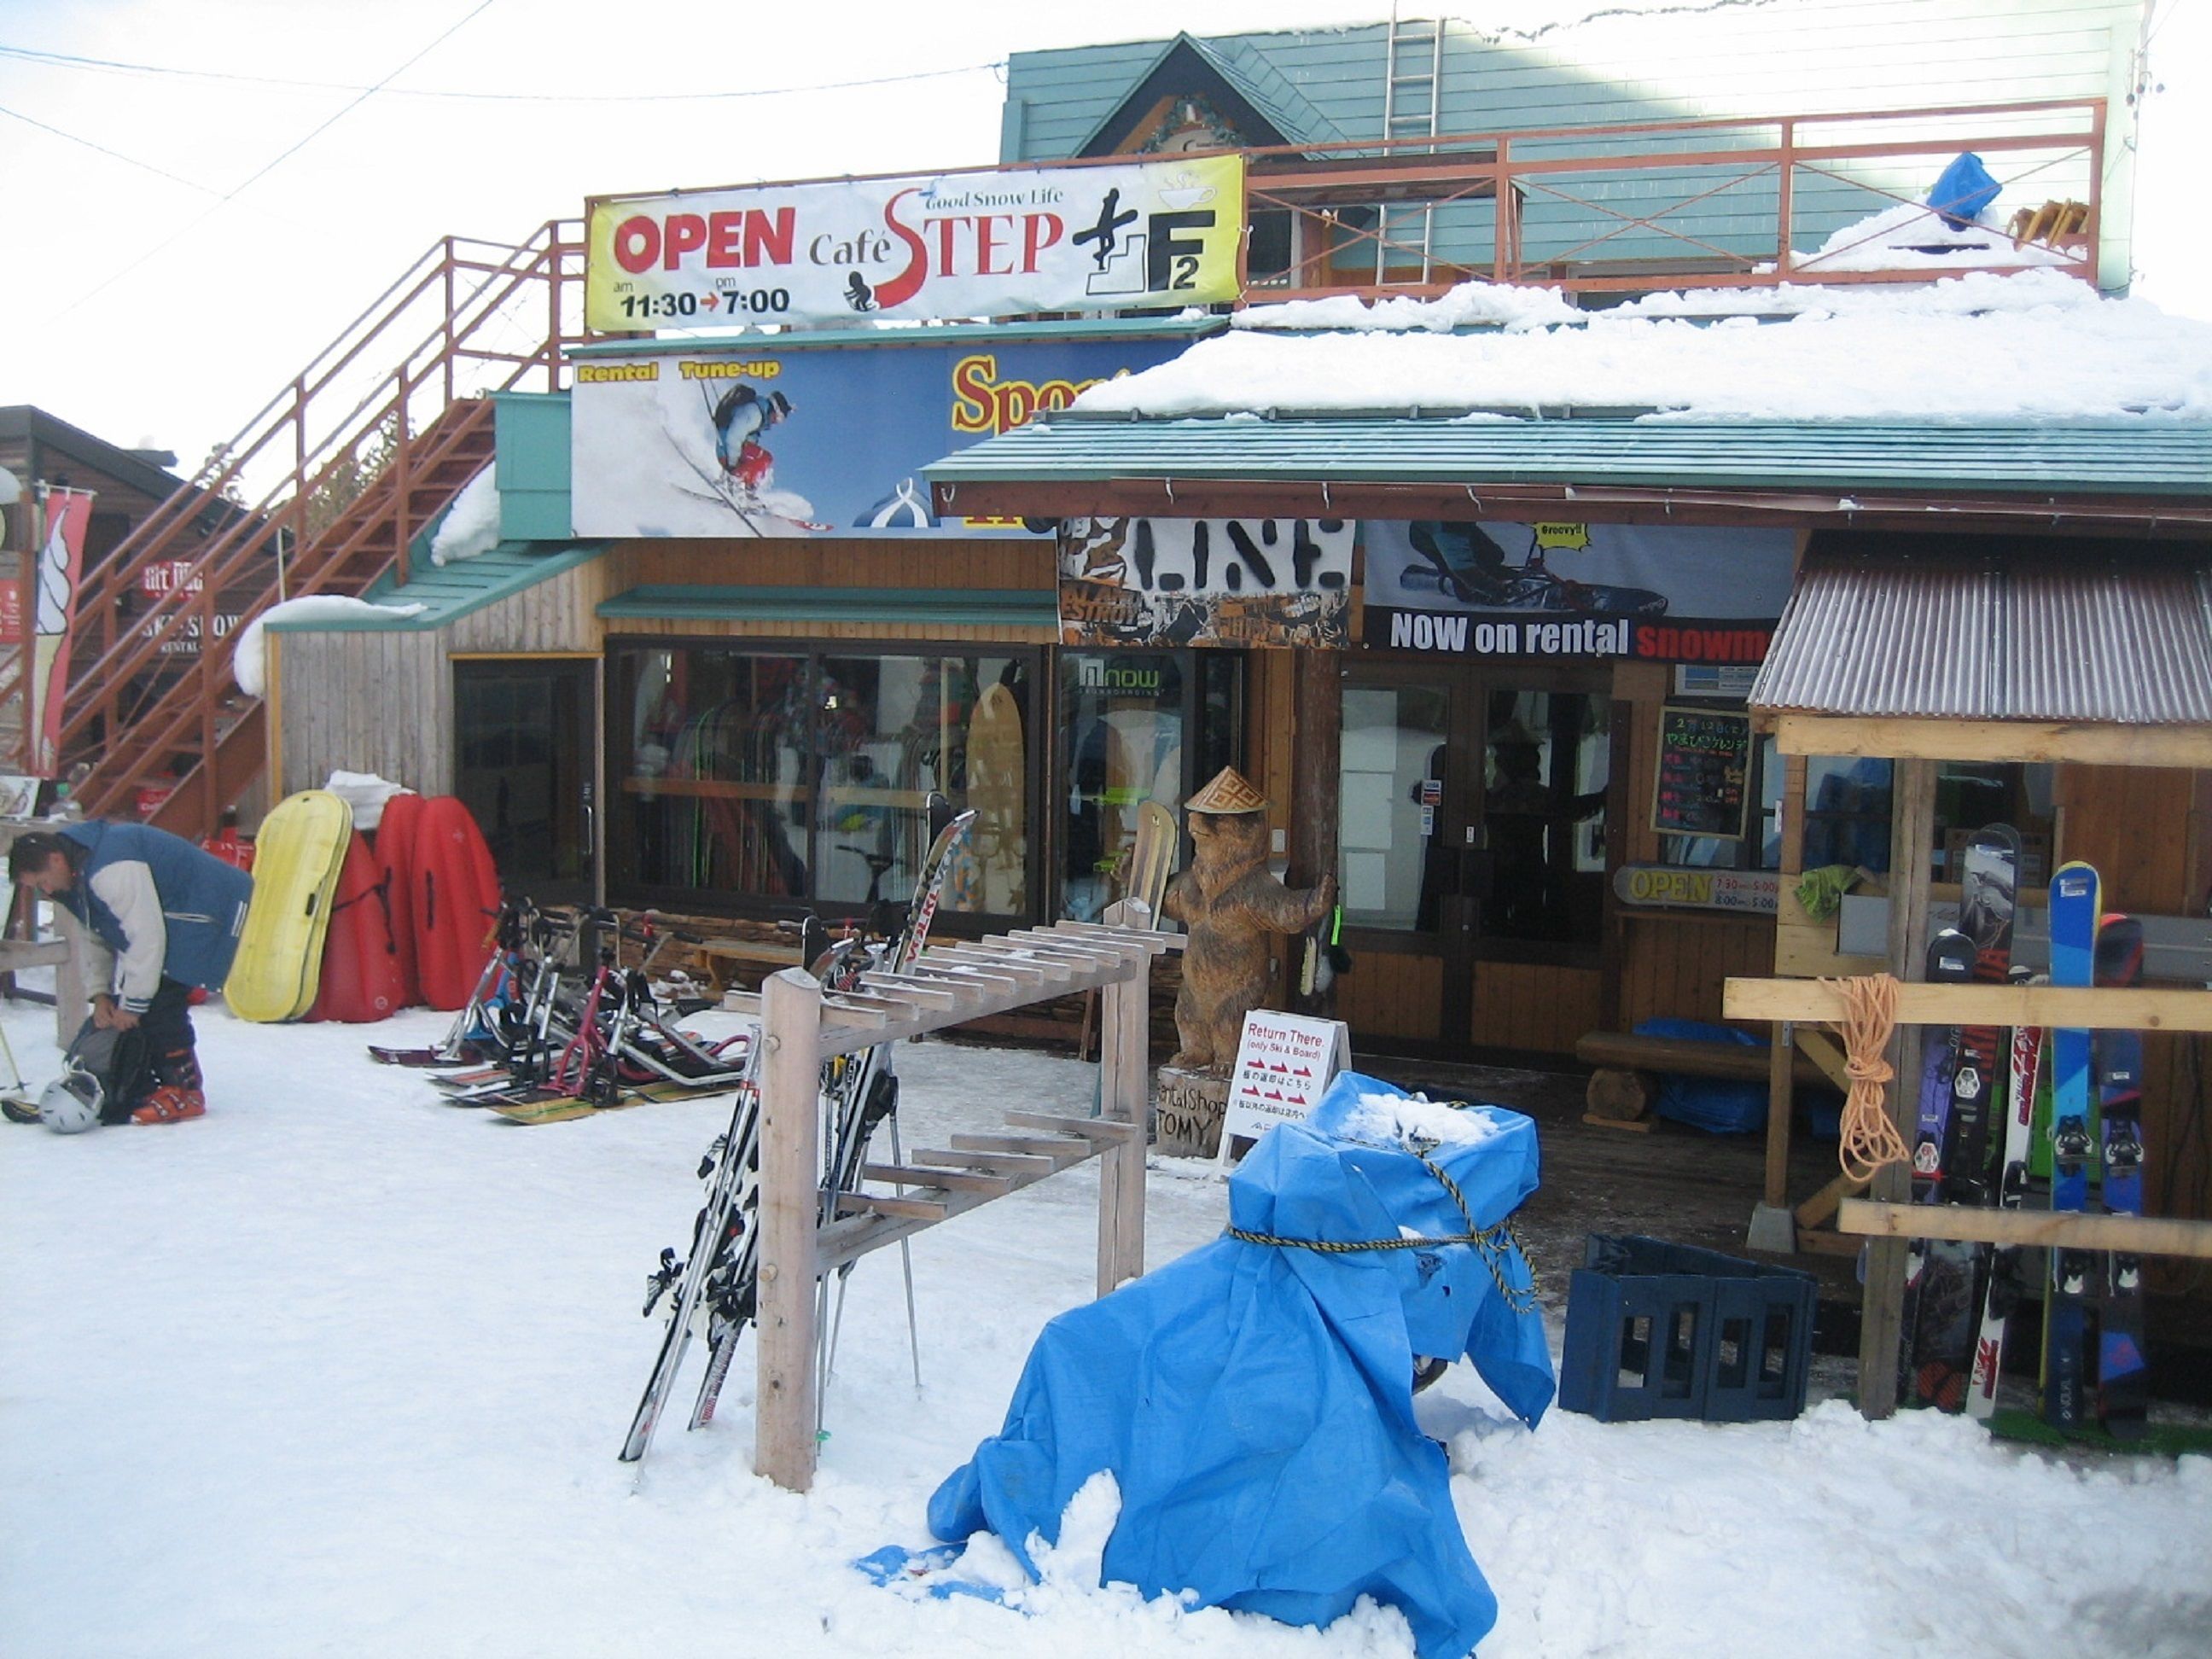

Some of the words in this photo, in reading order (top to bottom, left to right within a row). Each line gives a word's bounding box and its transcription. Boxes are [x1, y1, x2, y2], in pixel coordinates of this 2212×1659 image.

[926, 194, 969, 210] Good
[974, 190, 1025, 206] Snow
[1031, 186, 1064, 204] Life
[614, 207, 796, 275] OPEN
[808, 230, 891, 266] Café
[874, 187, 1064, 310] STEP
[613, 281, 634, 294] am
[715, 275, 736, 289] pm
[620, 292, 697, 319] 11:30
[722, 288, 790, 315] 7:00
[578, 362, 659, 383] Rental
[679, 360, 782, 380] Tune-up
[1135, 519, 1345, 591] LINE
[1390, 612, 1468, 652] NOW
[1475, 621, 1517, 654] on
[1525, 618, 1629, 655] rental
[1637, 624, 1771, 663] snowm
[1630, 870, 1713, 903] OPEN
[1248, 1022, 1287, 1041] Return
[1248, 1039, 1268, 1053] (only
[1269, 1043, 1283, 1053] Ski
[1284, 1045, 1290, 1054] &
[1293, 1046, 1321, 1061] Board)
[1156, 1108, 1214, 1147] TOMY
